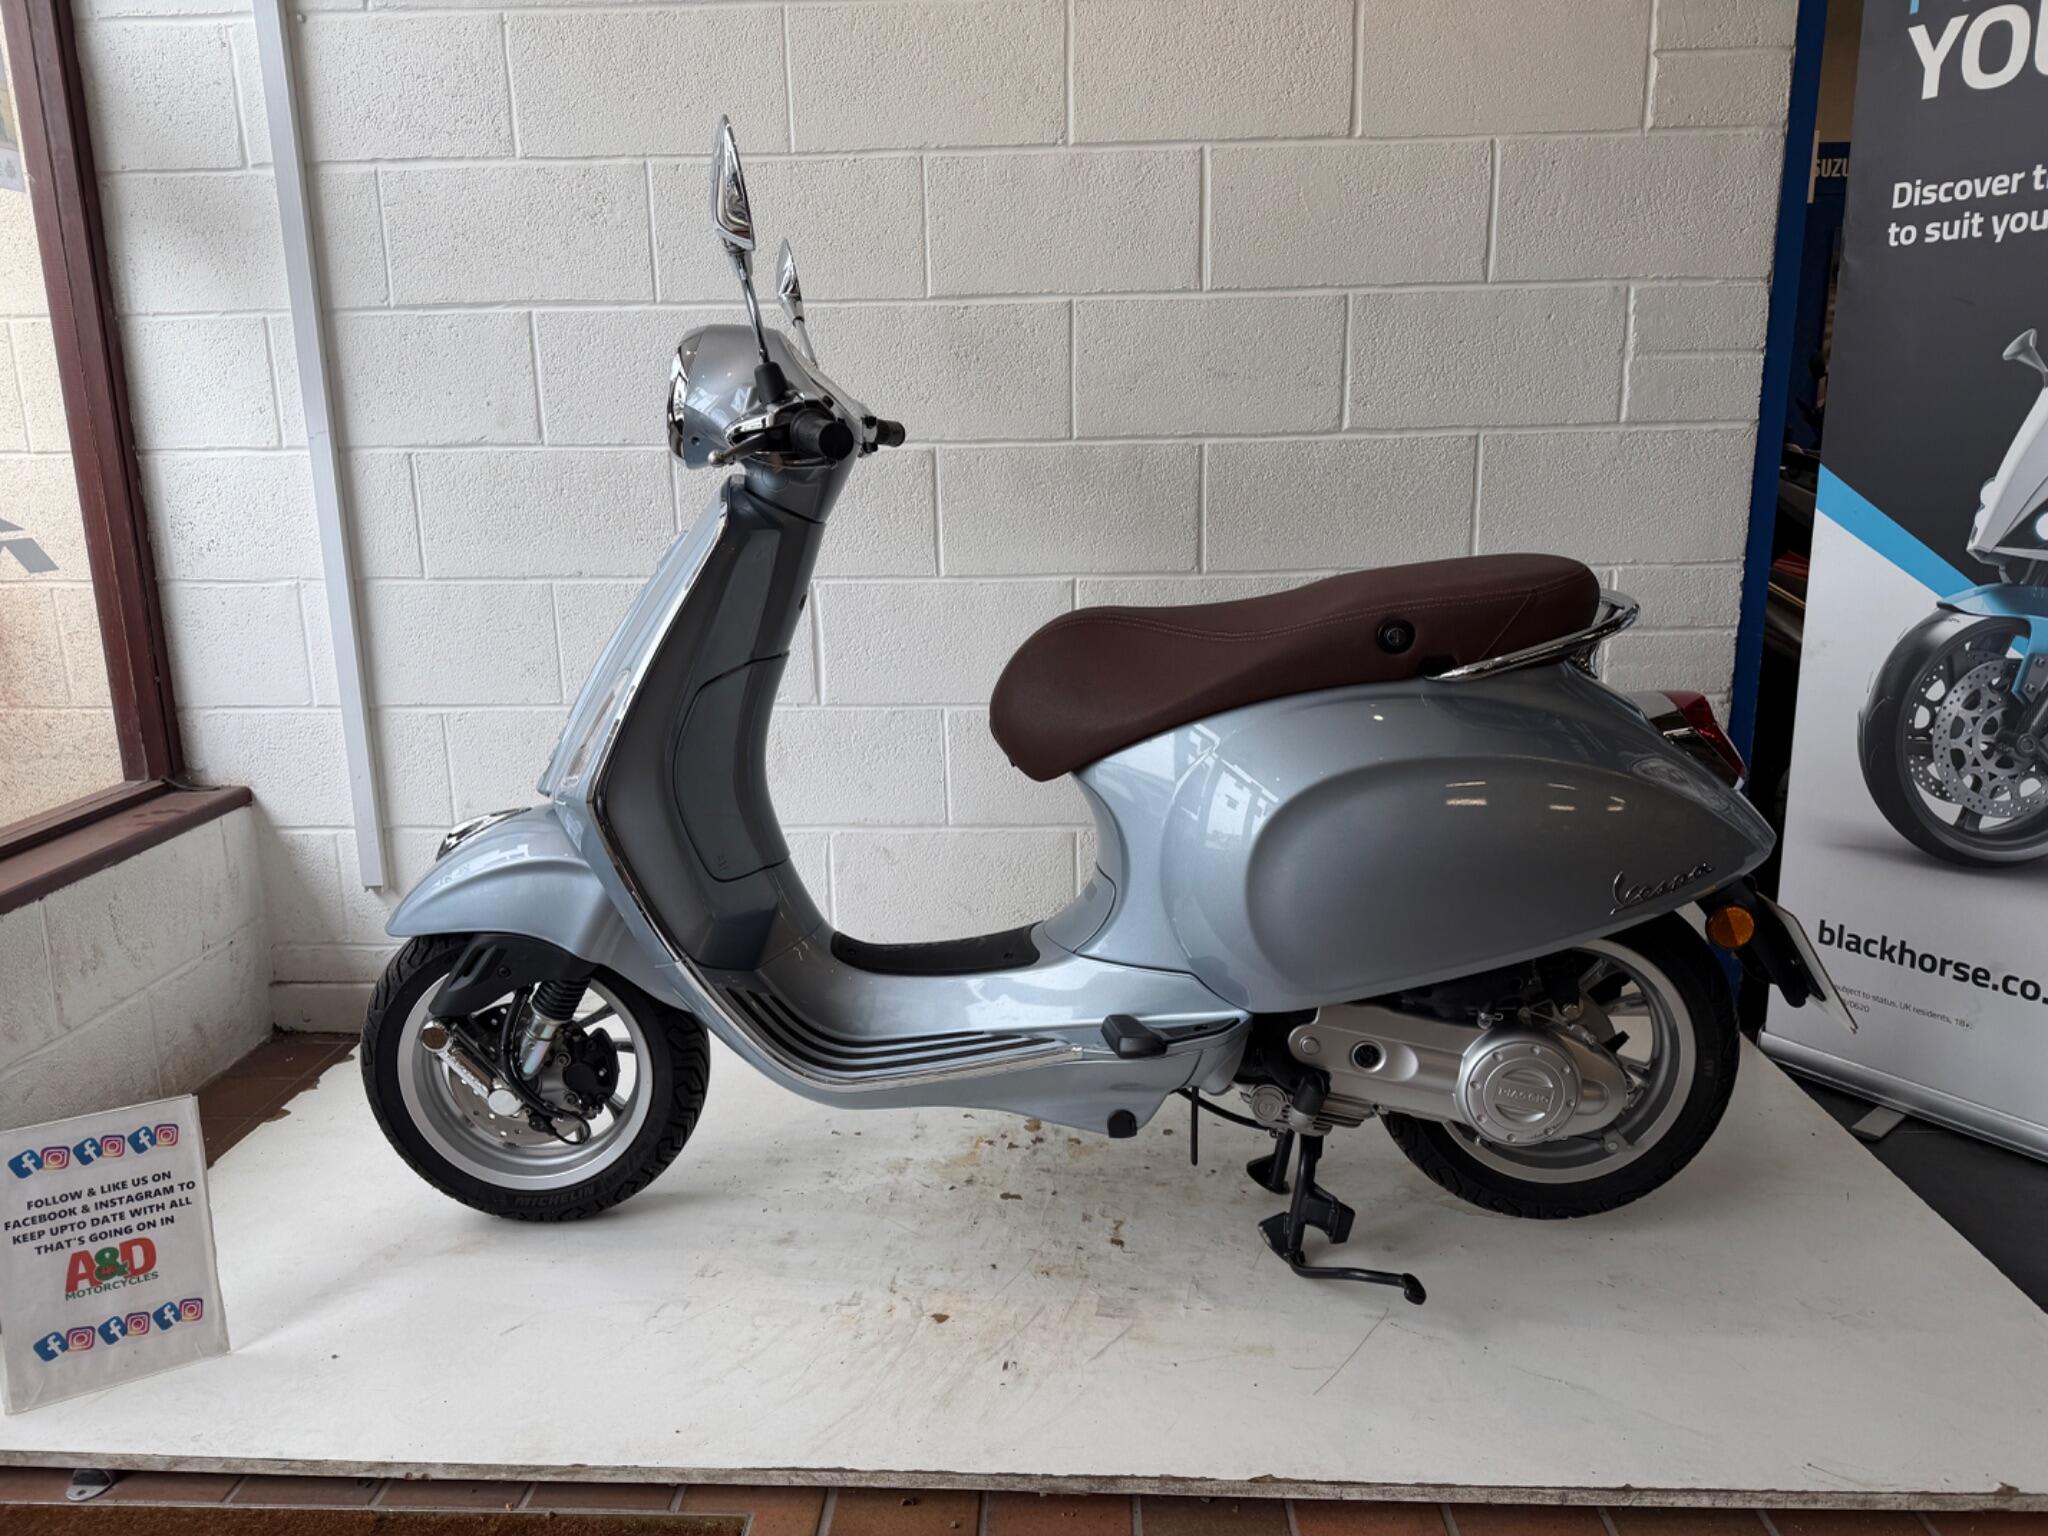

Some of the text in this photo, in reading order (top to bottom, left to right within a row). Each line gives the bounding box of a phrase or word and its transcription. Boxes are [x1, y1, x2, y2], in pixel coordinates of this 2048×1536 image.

[1908, 0, 2048, 100] YO
[1892, 171, 2026, 209] Discover
[1888, 222, 1917, 247] to
[1924, 211, 1984, 243] suit
[1609, 863, 1713, 916] Vespa
[1862, 992, 1871, 1000] to
[1899, 1002, 1913, 1013] UK
[3, 1180, 196, 1232] FACEBOOK & INSTAGRAM TO
[26, 1170, 173, 1211] FOLLOW & LIKE US ON
[515, 1184, 594, 1207] MICHELIN
[11, 1196, 193, 1246] KEEP UPTO DATE WITH ALL
[34, 1215, 176, 1256] THAT'S GOING ON IN
[65, 1237, 157, 1293] A&D
[64, 1270, 160, 1302] MOTORCYCLES
